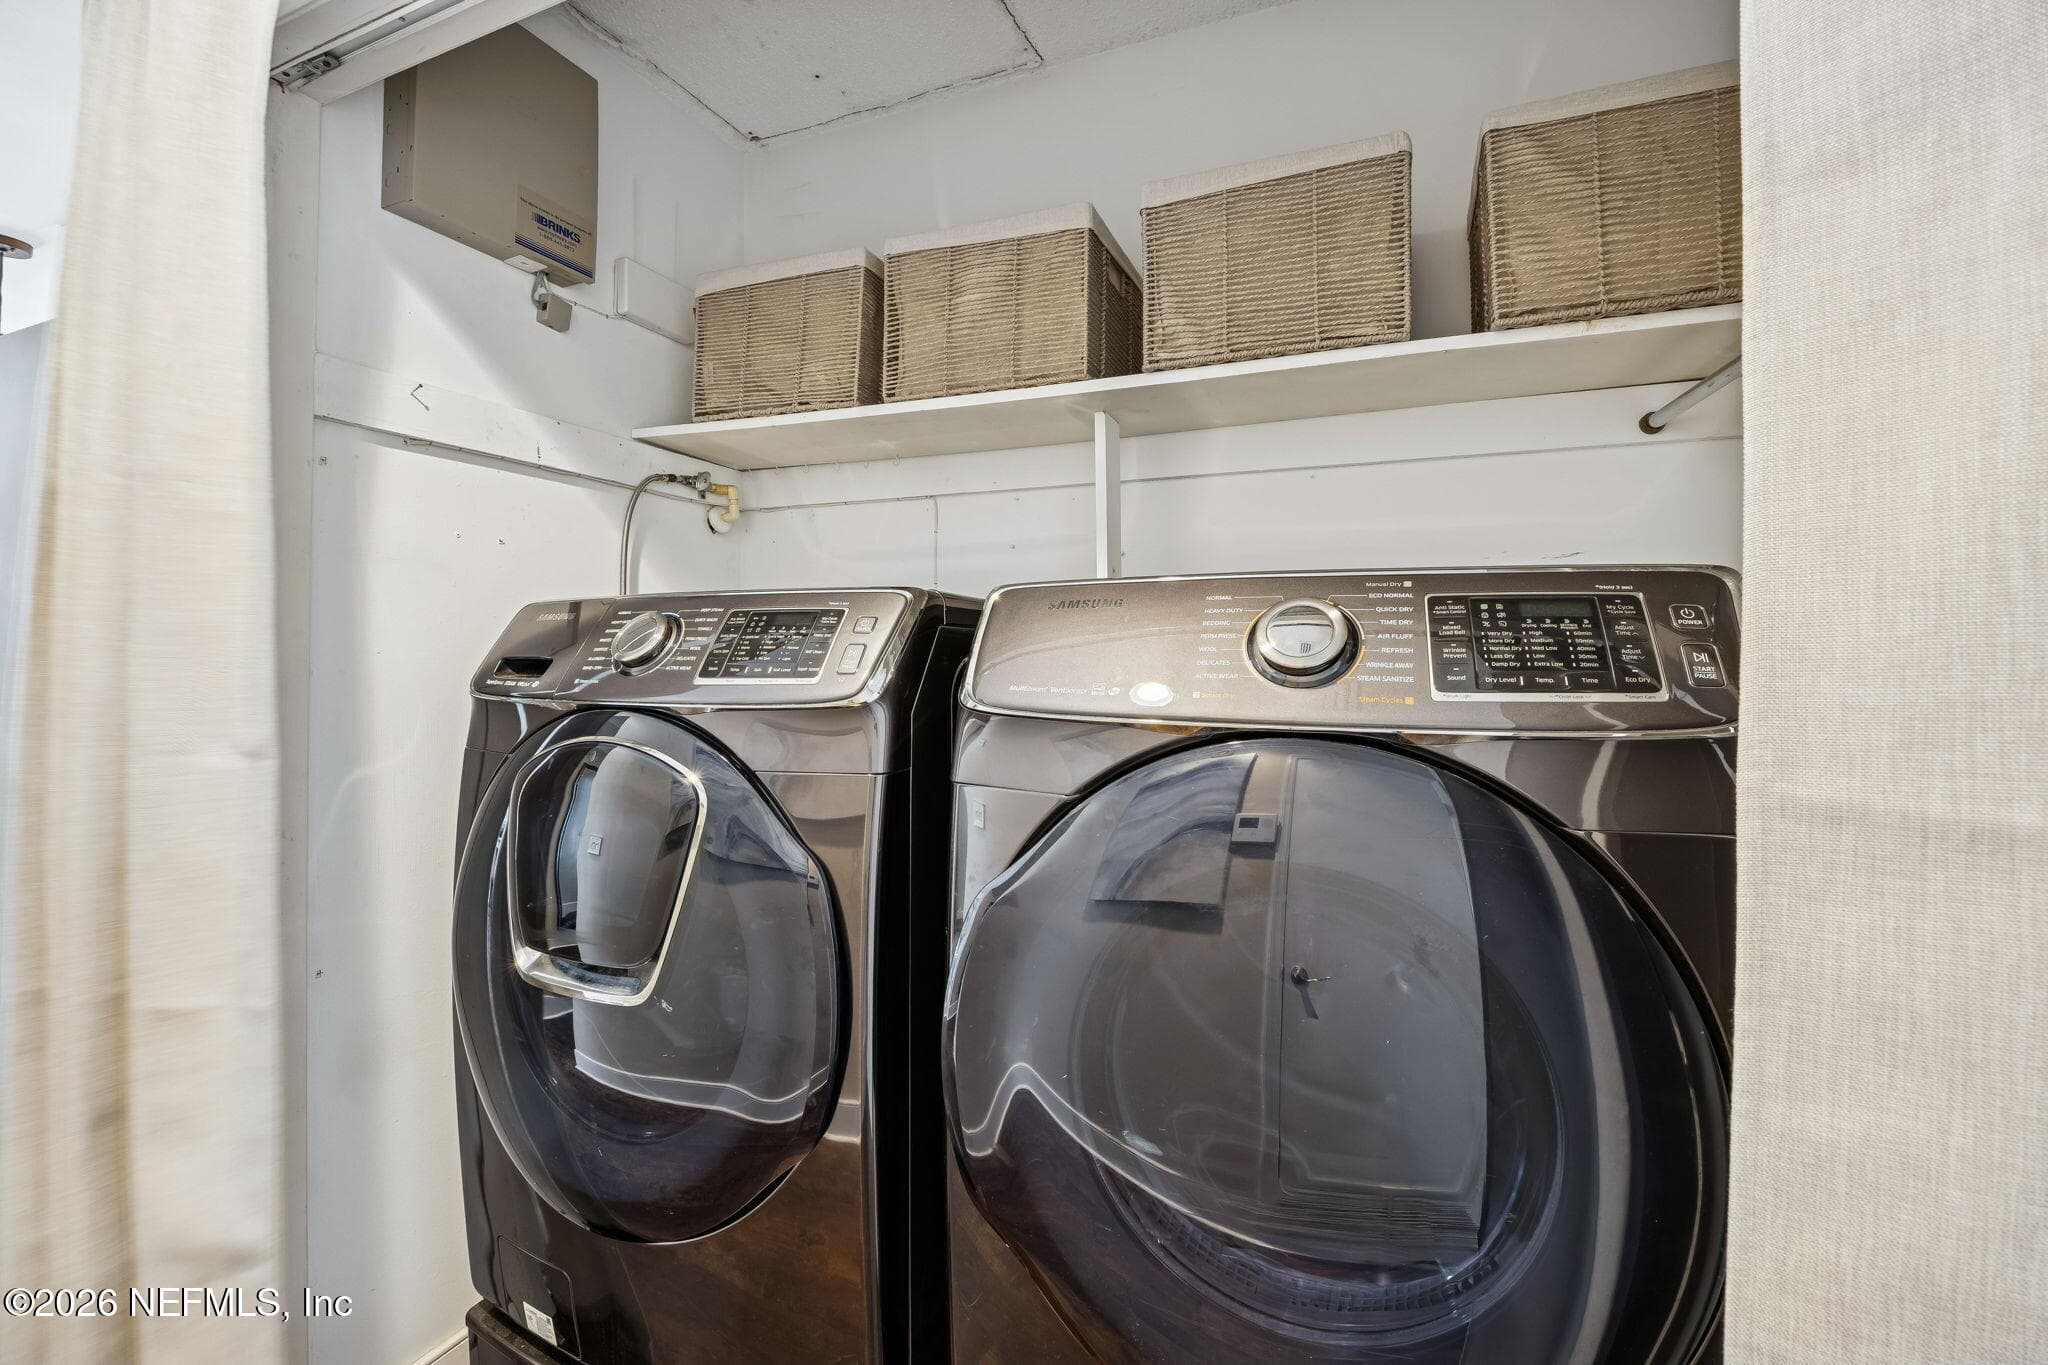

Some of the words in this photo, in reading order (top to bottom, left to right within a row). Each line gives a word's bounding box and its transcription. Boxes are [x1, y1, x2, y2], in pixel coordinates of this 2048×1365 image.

[539, 213, 582, 244] BRINKS
[1206, 592, 1233, 601] NORMAL
[1047, 598, 1125, 611] SAMSUNG
[1381, 675, 1415, 683] SANITIZE
[1638, 676, 1651, 684] Dry
